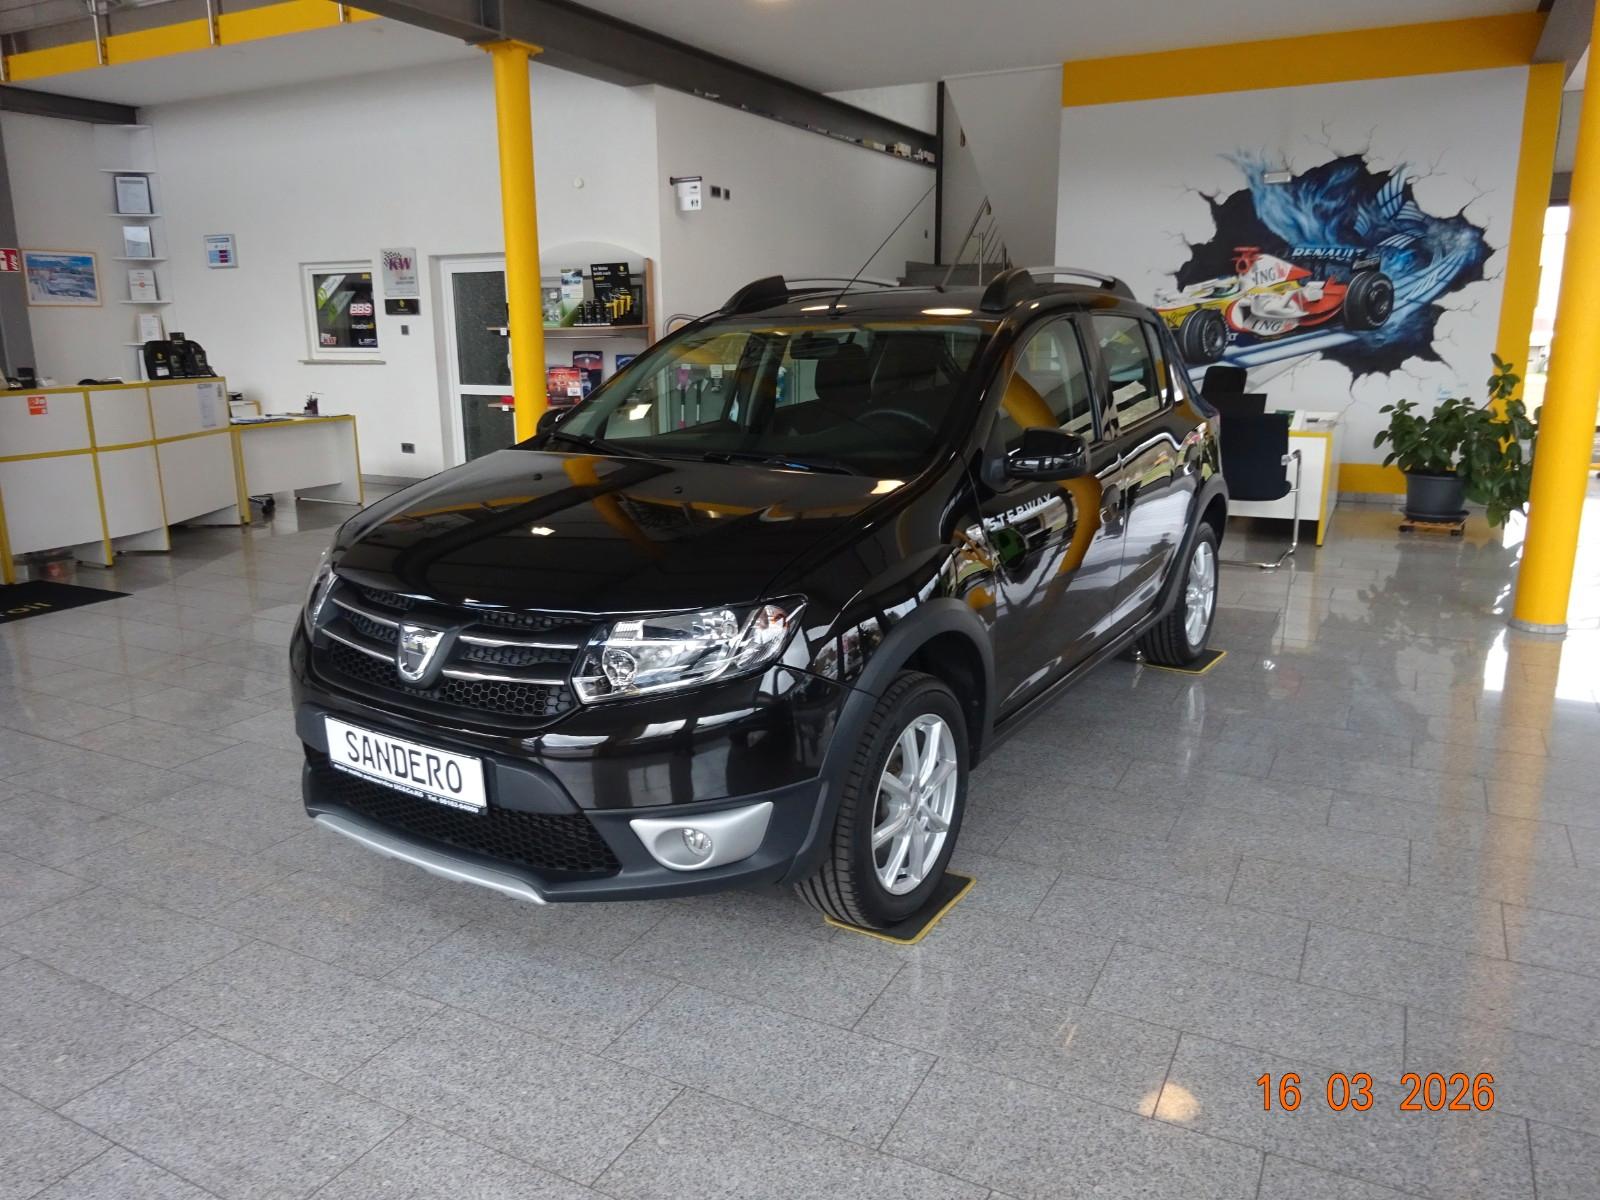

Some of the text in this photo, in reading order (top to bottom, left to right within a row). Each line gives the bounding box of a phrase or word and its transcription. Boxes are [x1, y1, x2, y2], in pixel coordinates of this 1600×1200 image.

[389, 257, 412, 271] KW
[1252, 267, 1276, 285] ING
[350, 303, 373, 316] BBS
[1251, 319, 1281, 332] ING
[988, 493, 1053, 532] STEPWAY
[345, 730, 463, 793] SANDERO
